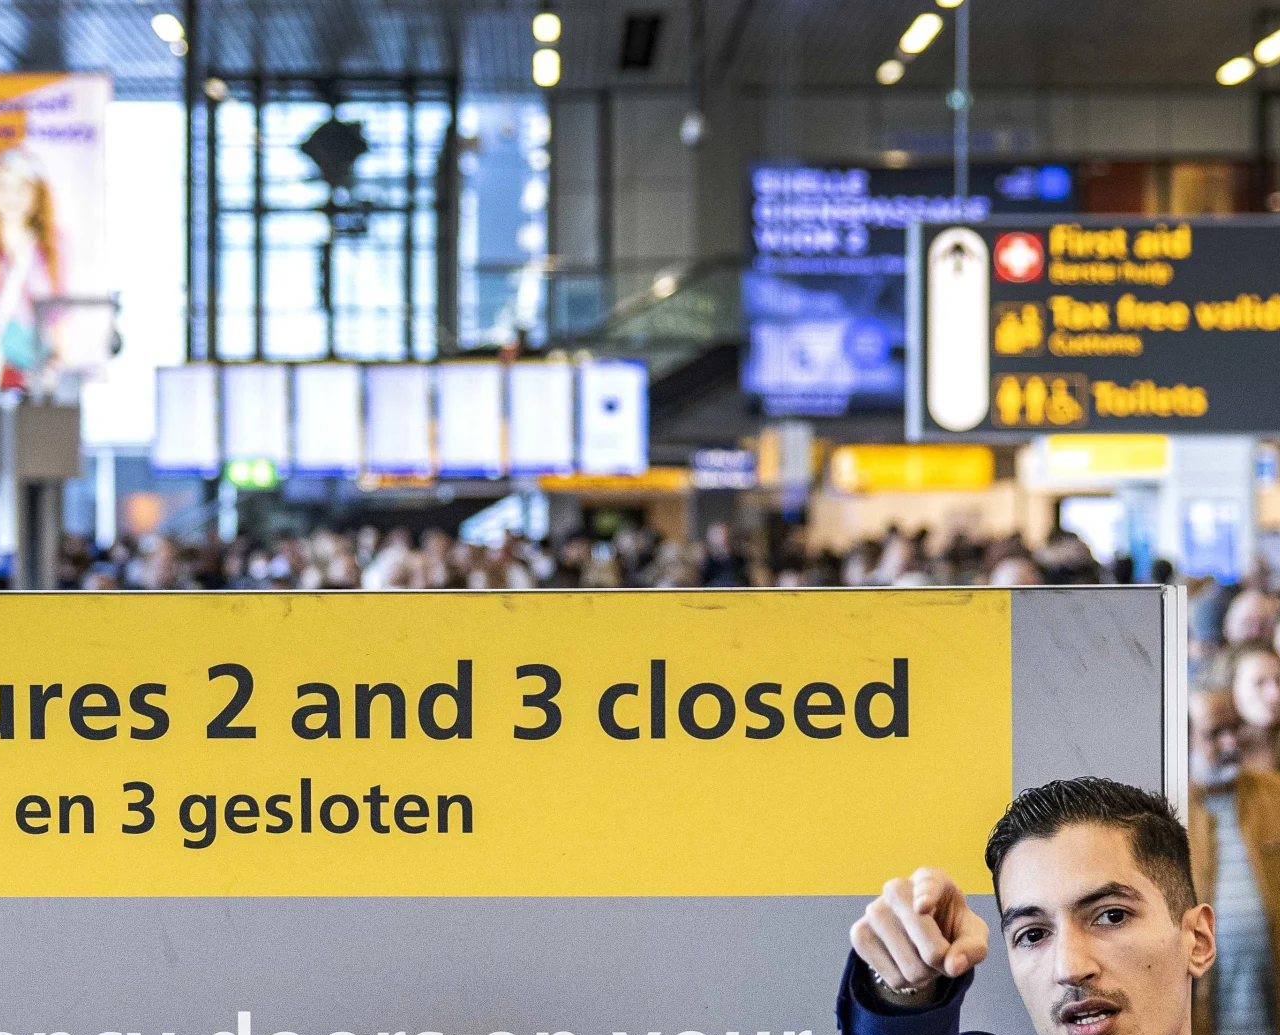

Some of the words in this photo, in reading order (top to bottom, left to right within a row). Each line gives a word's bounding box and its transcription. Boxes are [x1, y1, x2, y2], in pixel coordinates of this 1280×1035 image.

[1049, 223, 1127, 259] First
[1134, 223, 1192, 260] aid
[1050, 296, 1110, 331] Tax
[1117, 293, 1190, 331] free
[1093, 380, 1208, 417] Toilets
[206, 663, 257, 739] 2
[292, 659, 473, 740] and
[513, 663, 562, 740] 3
[598, 657, 909, 741] closed
[16, 795, 95, 835] en
[121, 782, 154, 835] 3
[179, 778, 473, 849] gesloten
